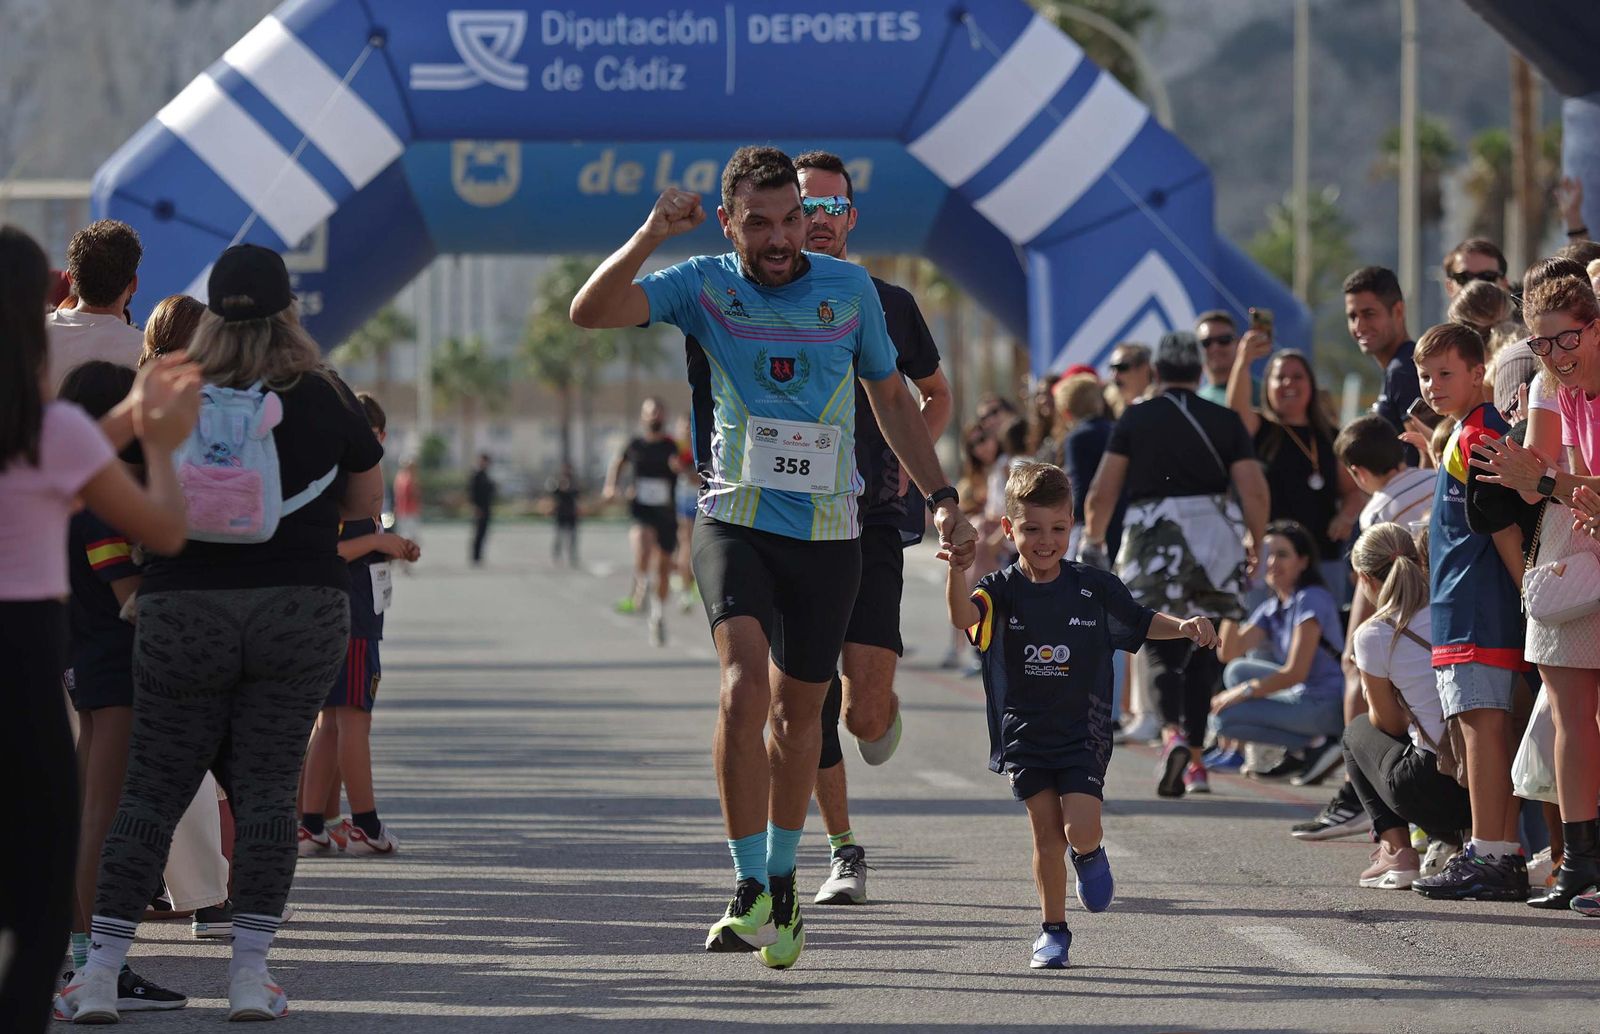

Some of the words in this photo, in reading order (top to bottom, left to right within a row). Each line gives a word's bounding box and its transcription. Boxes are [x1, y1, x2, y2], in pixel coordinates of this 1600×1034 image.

[540, 9, 718, 51] Diputación
[748, 10, 922, 44] DEPORTES
[541, 56, 584, 92] de
[594, 55, 687, 92] Cádiz
[577, 149, 643, 194] de
[653, 149, 720, 194] La
[773, 456, 811, 476] 358
[1024, 644, 1071, 664] 200
